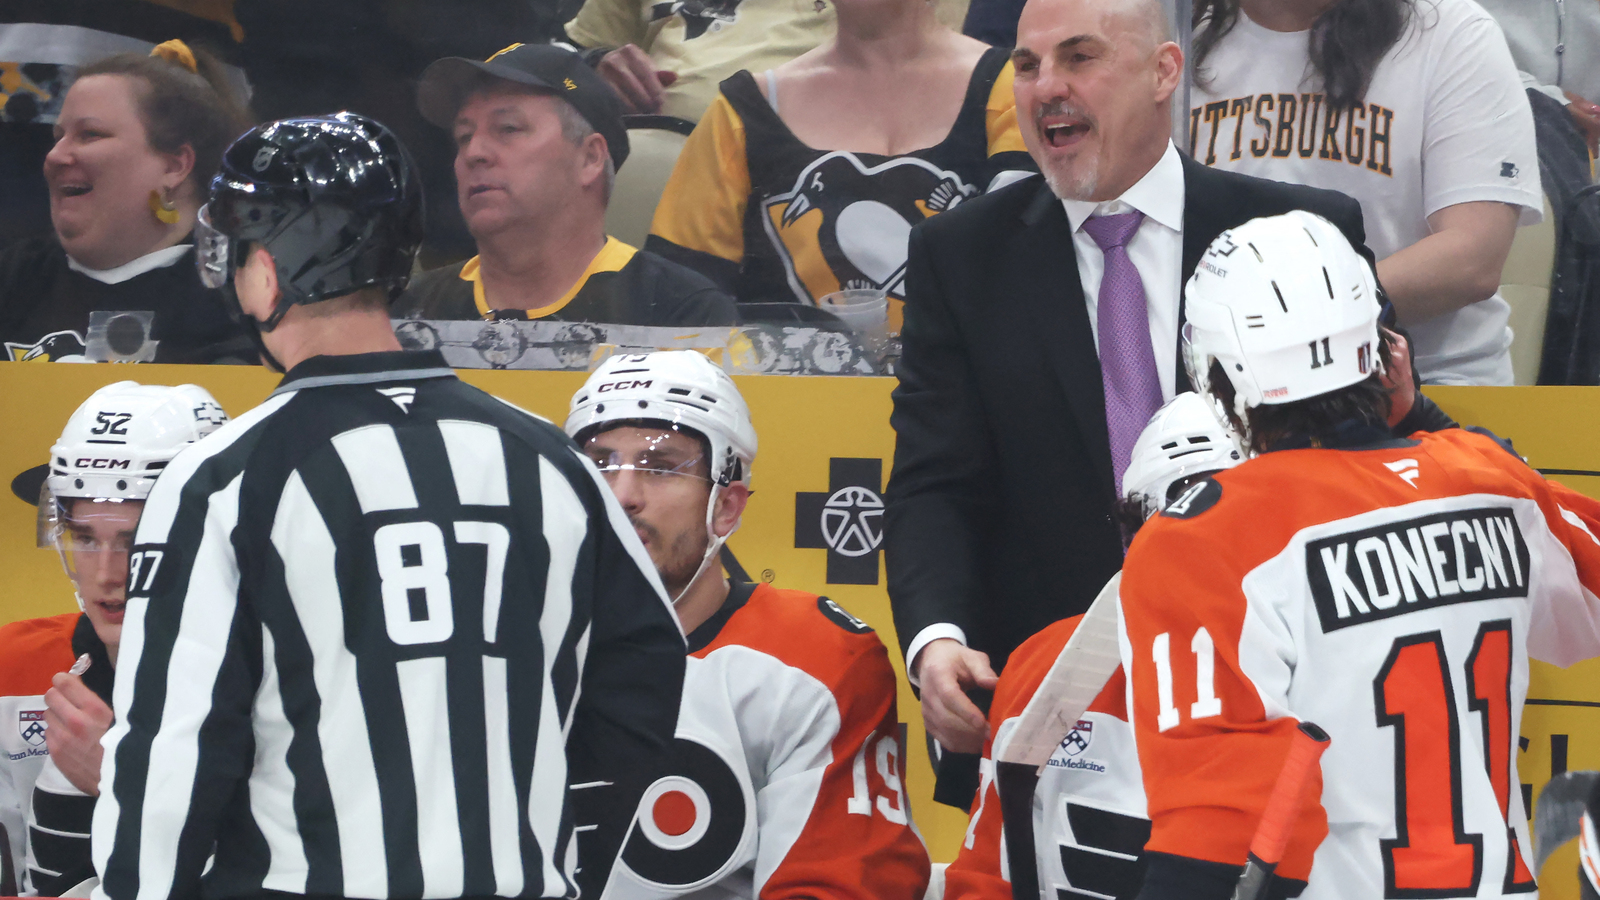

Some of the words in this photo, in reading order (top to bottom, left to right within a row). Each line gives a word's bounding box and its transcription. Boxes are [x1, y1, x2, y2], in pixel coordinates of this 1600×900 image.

[1189, 93, 1394, 178] ITTSBURGH
[598, 379, 653, 393] CCM
[1308, 336, 1334, 370] 11
[75, 458, 131, 470] CCM
[90, 411, 133, 435] 52
[373, 521, 510, 645] 87
[1320, 516, 1524, 619] KONECNY
[1151, 627, 1222, 733] 11
[847, 729, 908, 826] 19
[1060, 757, 1106, 773] Medicine
[1372, 618, 1538, 899] 11
